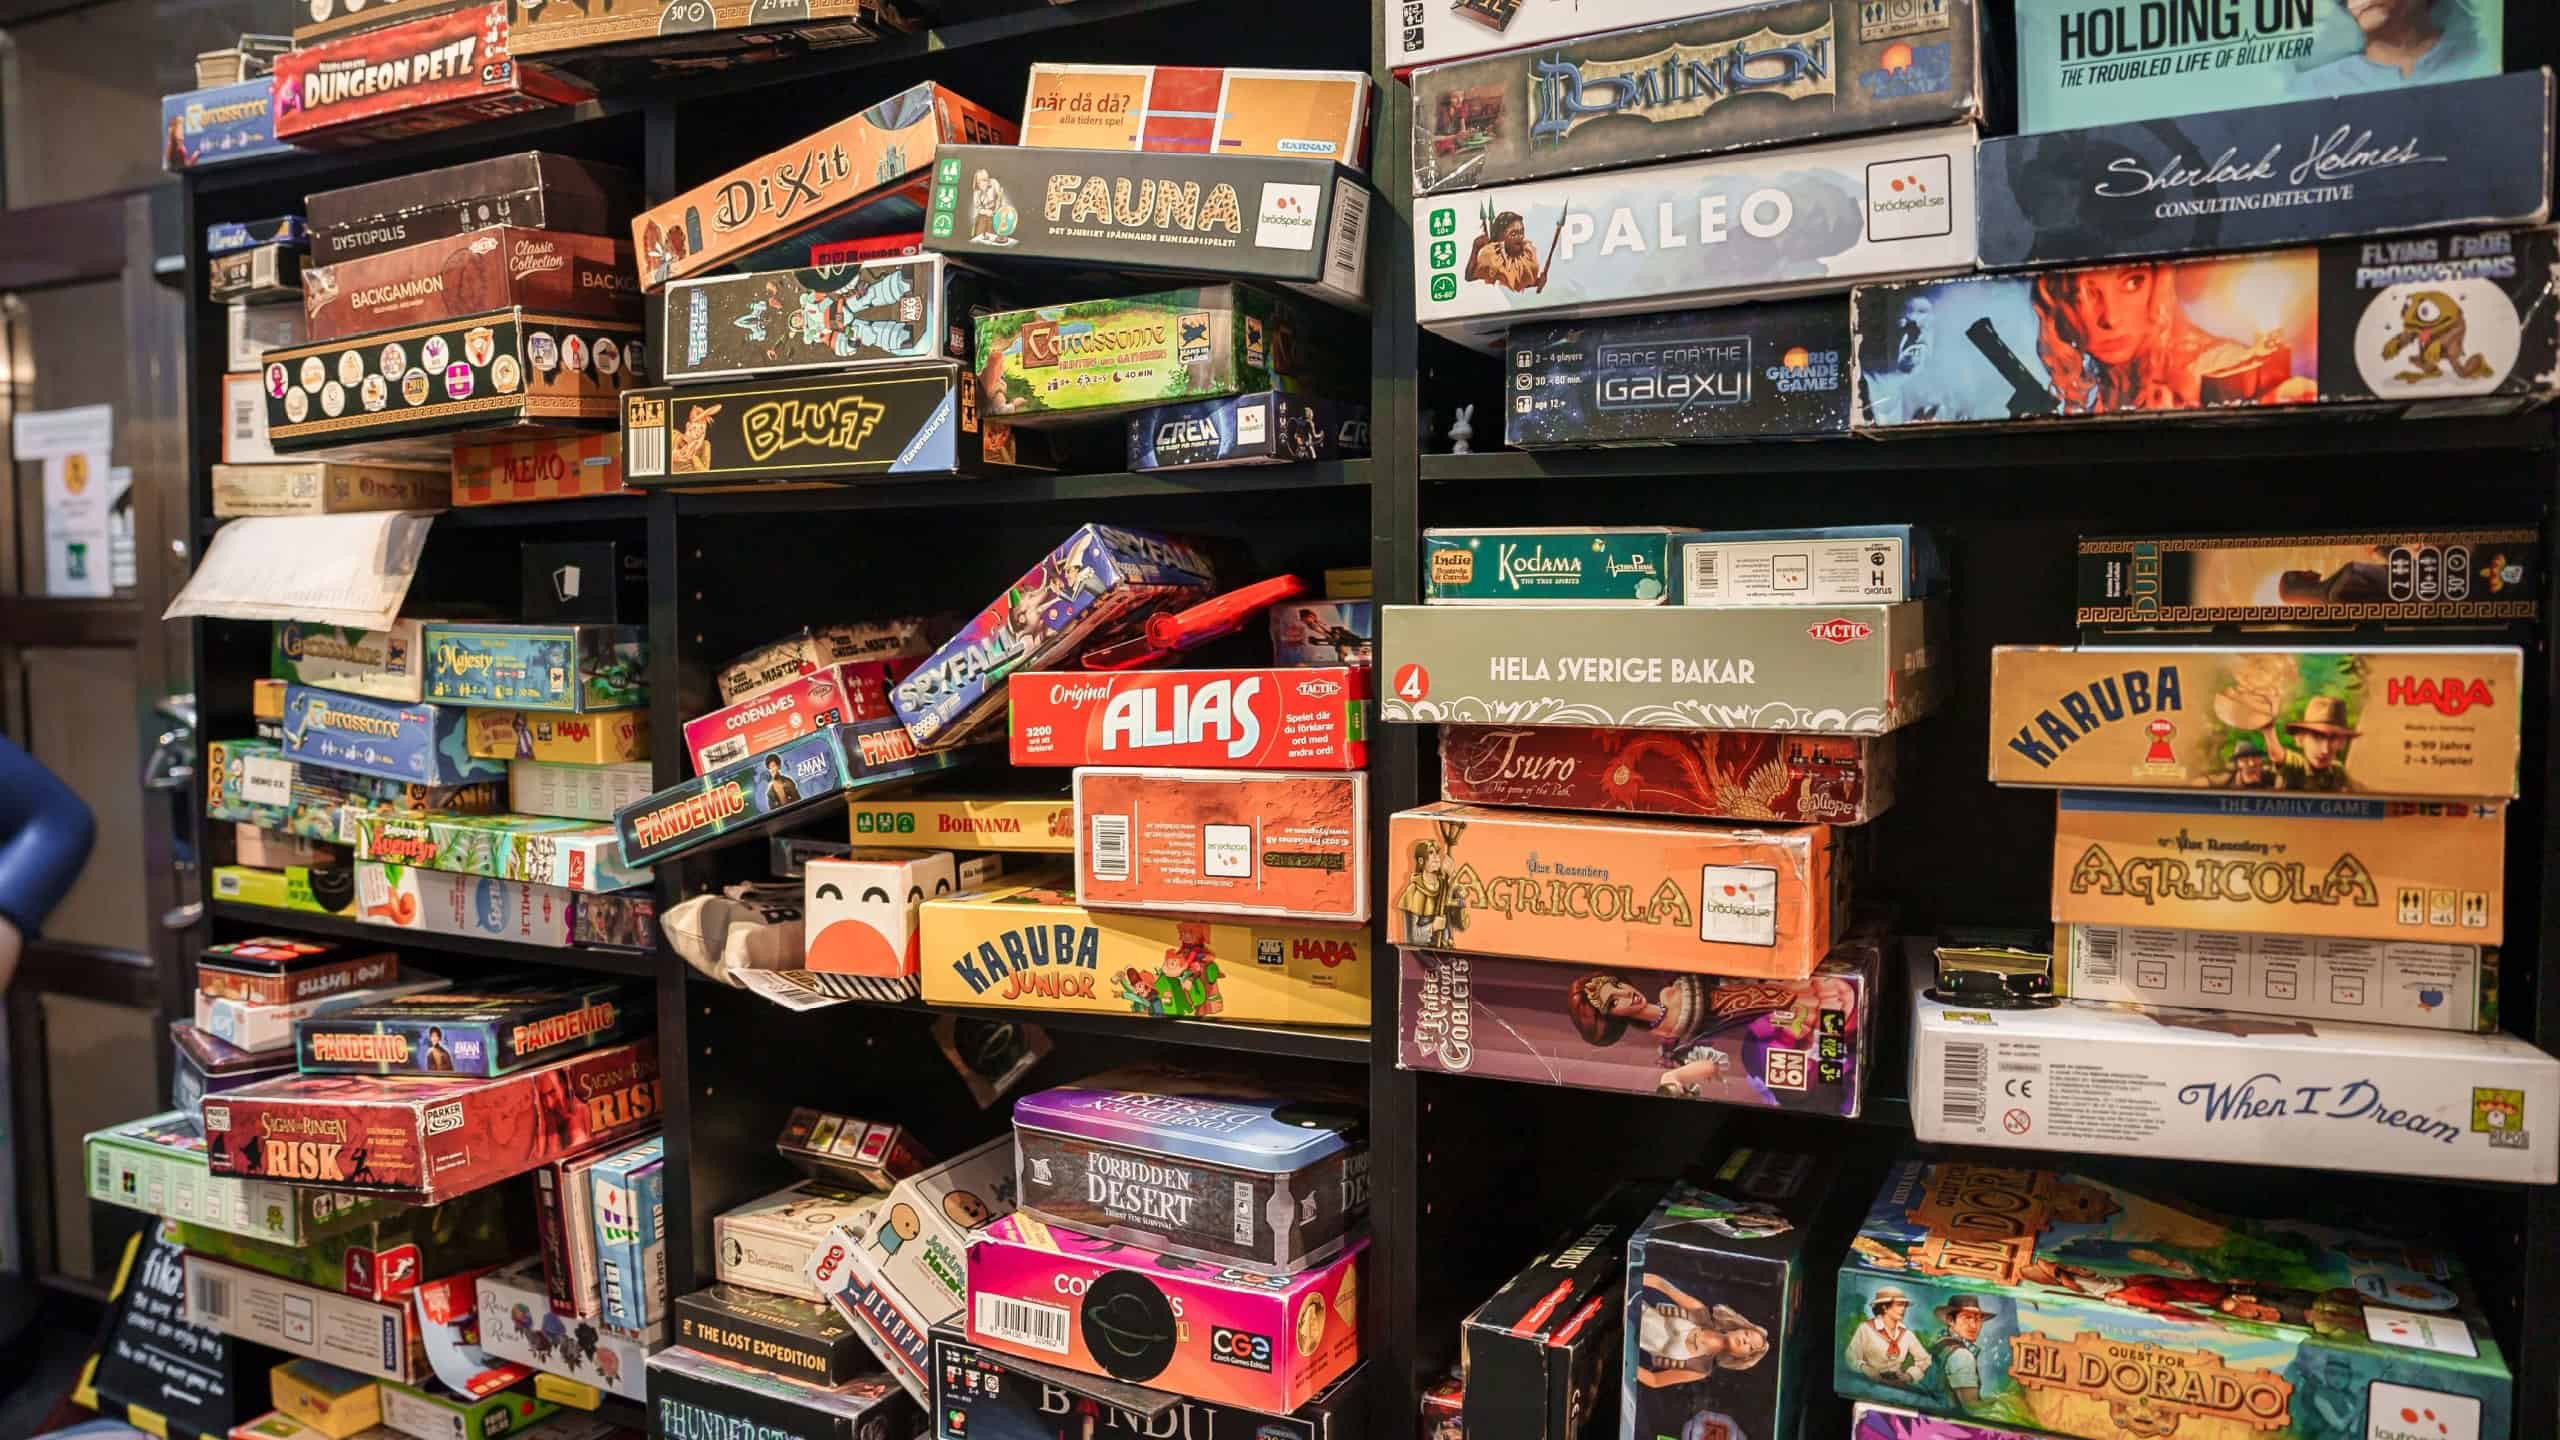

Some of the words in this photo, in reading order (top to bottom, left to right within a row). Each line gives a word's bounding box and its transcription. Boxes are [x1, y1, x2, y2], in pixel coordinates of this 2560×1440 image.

[2061, 0, 2240, 61] HOLDING
[2255, 0, 2315, 34] ON
[304, 59, 409, 108] DUNGEON
[412, 36, 477, 84] PETZ
[2060, 69, 2084, 88] THE
[2088, 57, 2172, 83] TROUBLED
[2176, 52, 2210, 73] LIFE
[2214, 50, 2233, 68] OF
[2235, 44, 2274, 66] BILLY
[2276, 38, 2313, 60] KERR
[1034, 91, 1066, 113] när
[1069, 91, 1094, 113] då
[1098, 92, 1131, 114] då?
[1059, 115, 1076, 125] alla
[1077, 115, 1103, 126] tiders
[1105, 116, 1125, 128] spel
[2095, 144, 2283, 197] Sherlock
[2290, 124, 2447, 184] Holmes
[1044, 174, 1242, 233] FAUNA
[2155, 193, 2260, 219] CONSULTING
[2262, 184, 2353, 209] DETECTIVE
[331, 225, 407, 250] DYSTOPOLIS
[1560, 188, 1794, 261] PALEO
[510, 255, 565, 275] Collection
[514, 240, 555, 259] Classic
[2362, 240, 2439, 265] FLYING
[2450, 233, 2512, 258] FROG
[2356, 256, 2518, 288] PRODUCTIONS
[351, 274, 444, 309] BACKGAMMON
[1606, 350, 1656, 367] RACE
[1662, 348, 1700, 365] FOR
[1703, 345, 1741, 362] THE
[1766, 363, 1839, 380] GRANDE
[1807, 350, 1839, 365] RIO
[1777, 378, 1839, 392] GAMES
[742, 395, 885, 462] BLUFF
[902, 403, 951, 465] Ravensburger
[1156, 417, 1221, 445] CREW
[503, 452, 566, 484] MEMO
[1435, 555, 1471, 566] Indie
[2136, 543, 2159, 614] DUEL
[1813, 624, 1867, 639] TACTIC
[437, 642, 493, 677] Majesty
[1490, 656, 1551, 682] HELA
[1557, 656, 1662, 684] SVERIGE
[1670, 658, 1756, 685] BAKAR
[1050, 678, 1113, 709] Original
[1299, 683, 1338, 696] TACTIC
[1400, 665, 1421, 699] 4
[2387, 675, 2494, 716] HABA
[725, 694, 796, 731] CODENAMES
[1102, 677, 1260, 759] ALIAS
[1284, 724, 1296, 733] du
[1297, 721, 1334, 733] förklarar
[1285, 713, 1310, 725] Spelet
[1312, 710, 1330, 721] där
[2007, 665, 2182, 768] KARUBA
[1025, 726, 1052, 738] 3200
[1291, 736, 1308, 745] ord
[1309, 734, 1329, 744] med
[1288, 748, 1313, 758] andra
[1314, 746, 1334, 756] ord!
[1464, 731, 1578, 786] Tsuro
[634, 781, 745, 848] PANDEMIC
[937, 813, 1021, 834] BOHNANZA
[2219, 798, 2257, 815] THE
[2261, 799, 2314, 816] FAMILY
[2321, 801, 2370, 817] GAME
[2070, 843, 2378, 907] AGRICOLA
[1448, 862, 1694, 927] AGRICOLA
[953, 923, 1099, 995] KARUBA
[1292, 938, 1357, 968] HABA
[1002, 969, 1097, 1001] JUNIOR
[513, 1002, 616, 1055] PANDEMIC
[312, 1033, 409, 1064] PANDEMIC
[427, 1104, 462, 1121] PARKER
[2178, 1073, 2286, 1123] When
[2296, 1087, 2332, 1115] I
[2326, 1079, 2461, 1145] Dream
[265, 1139, 346, 1182] RISK
[1087, 1151, 1191, 1188] FORBIDDEN
[1086, 1173, 1193, 1226] DESERT
[698, 1323, 721, 1343] THE
[721, 1328, 752, 1352] LOST
[753, 1336, 827, 1373] EXPEDITION
[2108, 1346, 2155, 1365] QUEST
[2157, 1351, 2186, 1367] FOR
[2016, 1341, 2067, 1381] EL
[2079, 1349, 2285, 1417] DORADO
